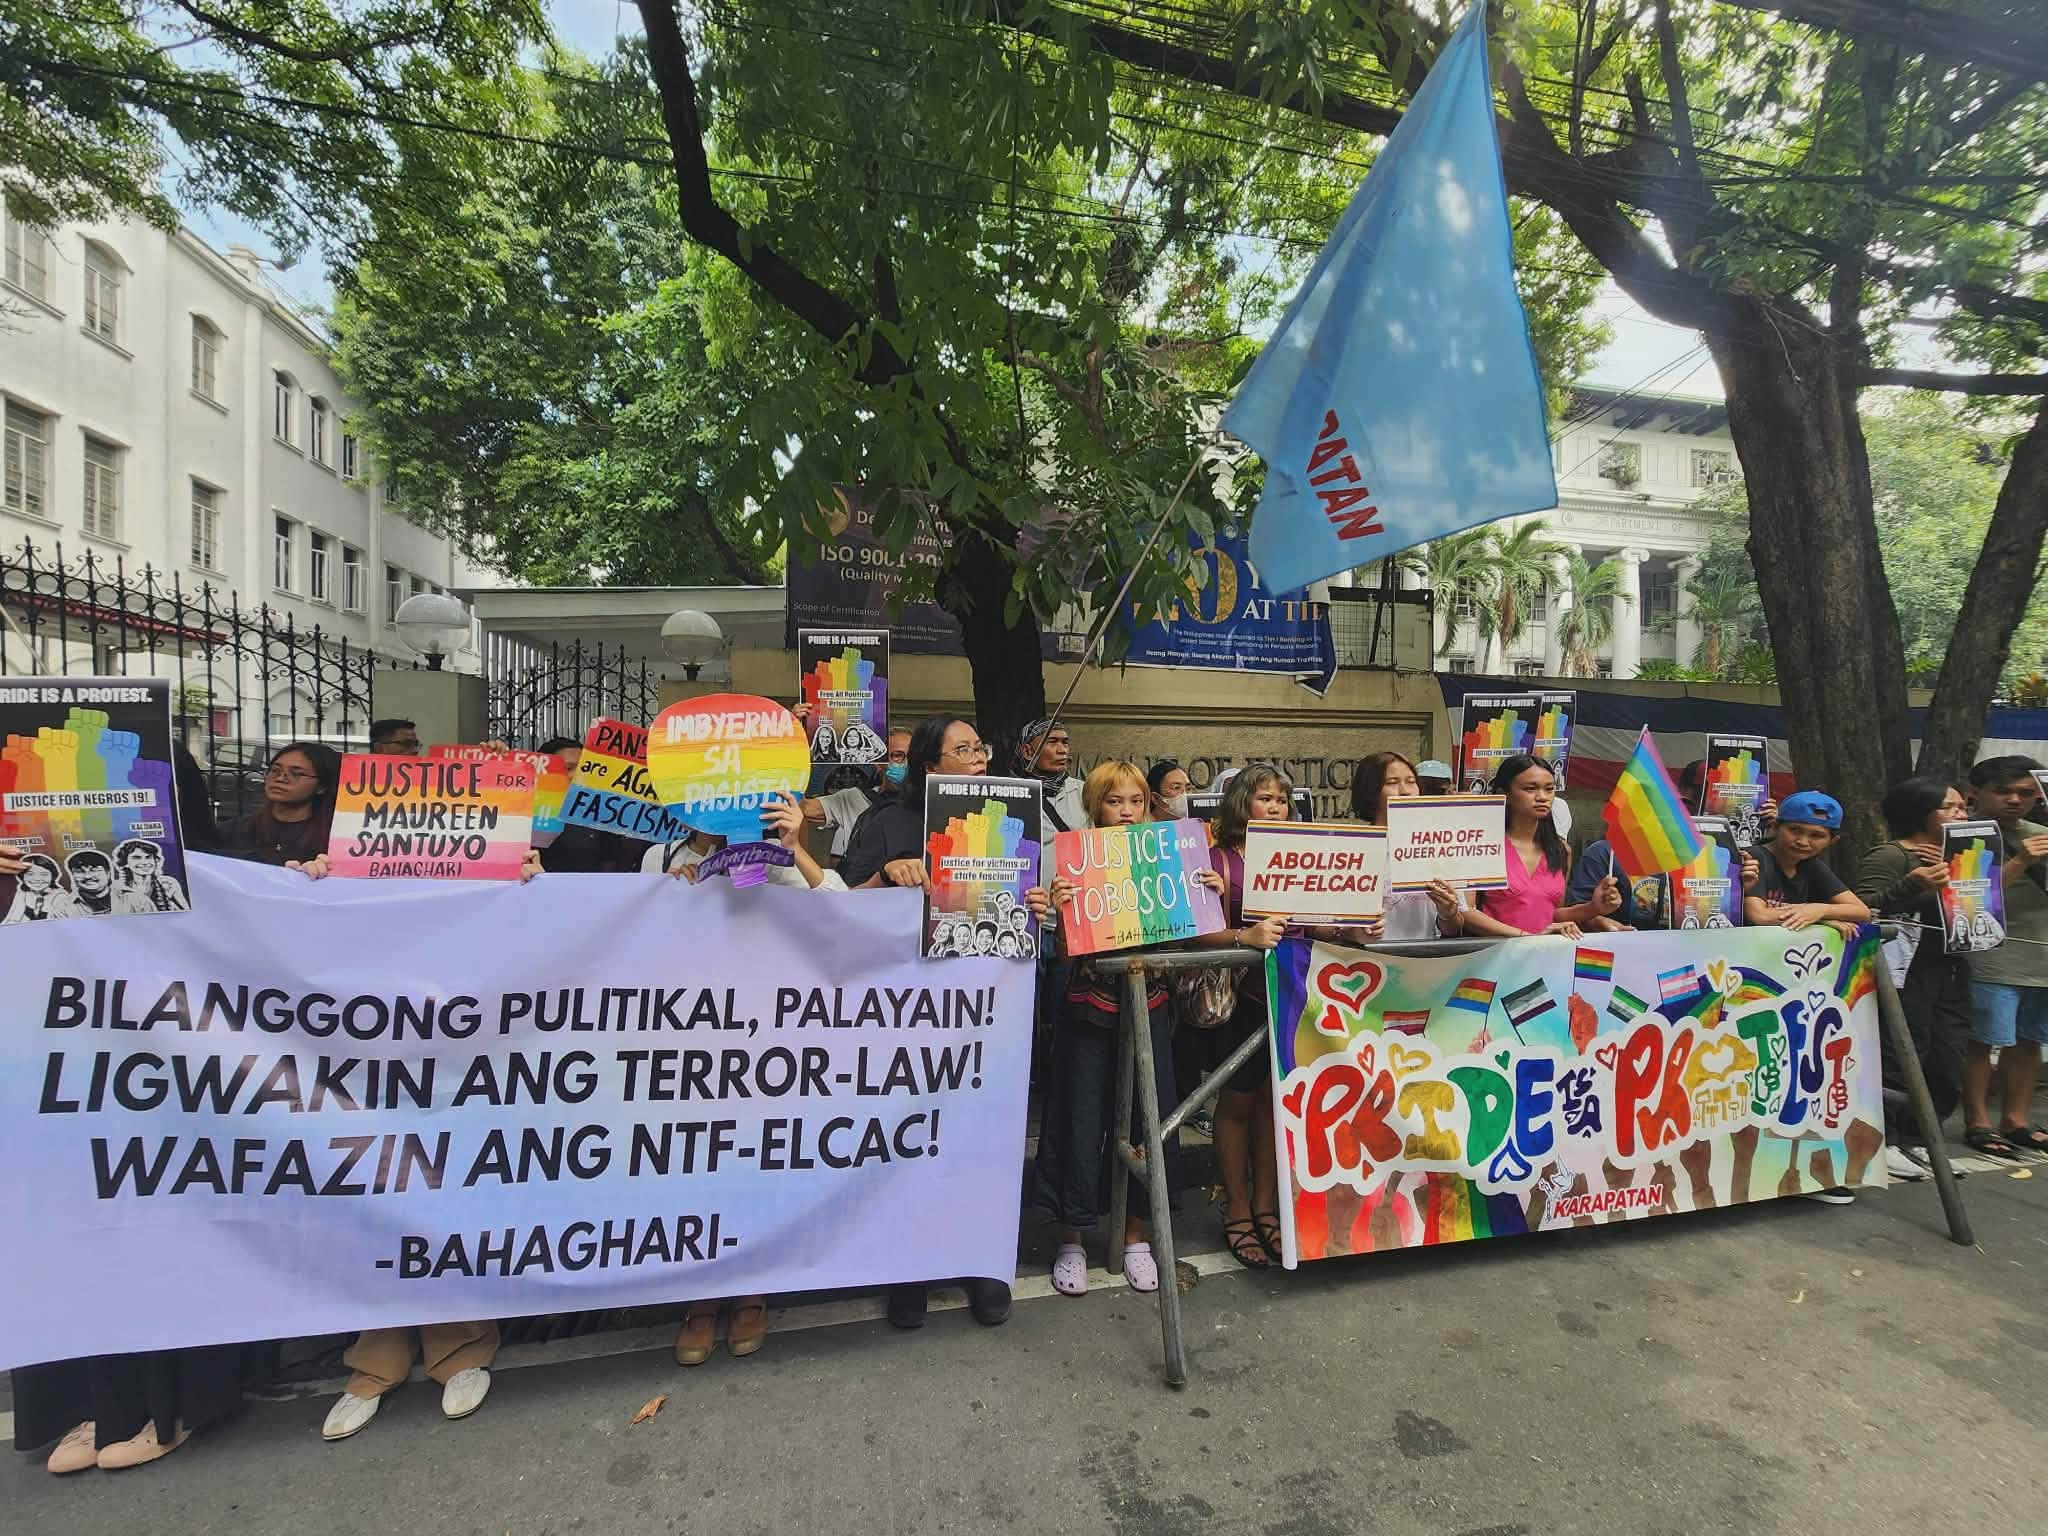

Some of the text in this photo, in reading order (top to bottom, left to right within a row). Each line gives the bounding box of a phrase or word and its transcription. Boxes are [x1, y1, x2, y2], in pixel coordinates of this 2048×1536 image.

[840, 566, 891, 584] (Quality
[1242, 599, 1277, 621] AT
[0, 687, 153, 703] RIDE IS A PROTEST.
[666, 710, 795, 744] IMBYERNA
[581, 760, 608, 776] are
[703, 744, 742, 776] SA
[346, 762, 528, 798] JUSTICE FOR
[939, 783, 969, 796] PRIDE
[969, 784, 981, 797] IS
[981, 784, 989, 797] A
[10, 789, 150, 809] JUSTICE FOR NEGROS 19!
[362, 801, 499, 831] MAUREEN
[348, 831, 488, 861] SANTUYO
[1411, 828, 1485, 845] HAND OFF
[1066, 828, 1197, 877] JUSTICE FOR
[1267, 851, 1365, 871] ABOLISH
[1394, 843, 1501, 862] QUEER ACTIVISTS!
[368, 860, 463, 879] BAHAGHARI
[1252, 873, 1379, 893] NTF-ELCAC!
[44, 976, 995, 1041] BILANGGONG PULITIKAL, PALAYAIN!
[38, 1041, 983, 1115] LIGWAKIN ANG TERROR-LAW!
[1305, 1058, 1555, 1179] PRIDE
[90, 1108, 941, 1199] WAFAZIN ANG NTF-ELCAC!
[1552, 1184, 1664, 1220] KARAPATAN
[375, 1213, 740, 1280] -BAHAGHARI-
